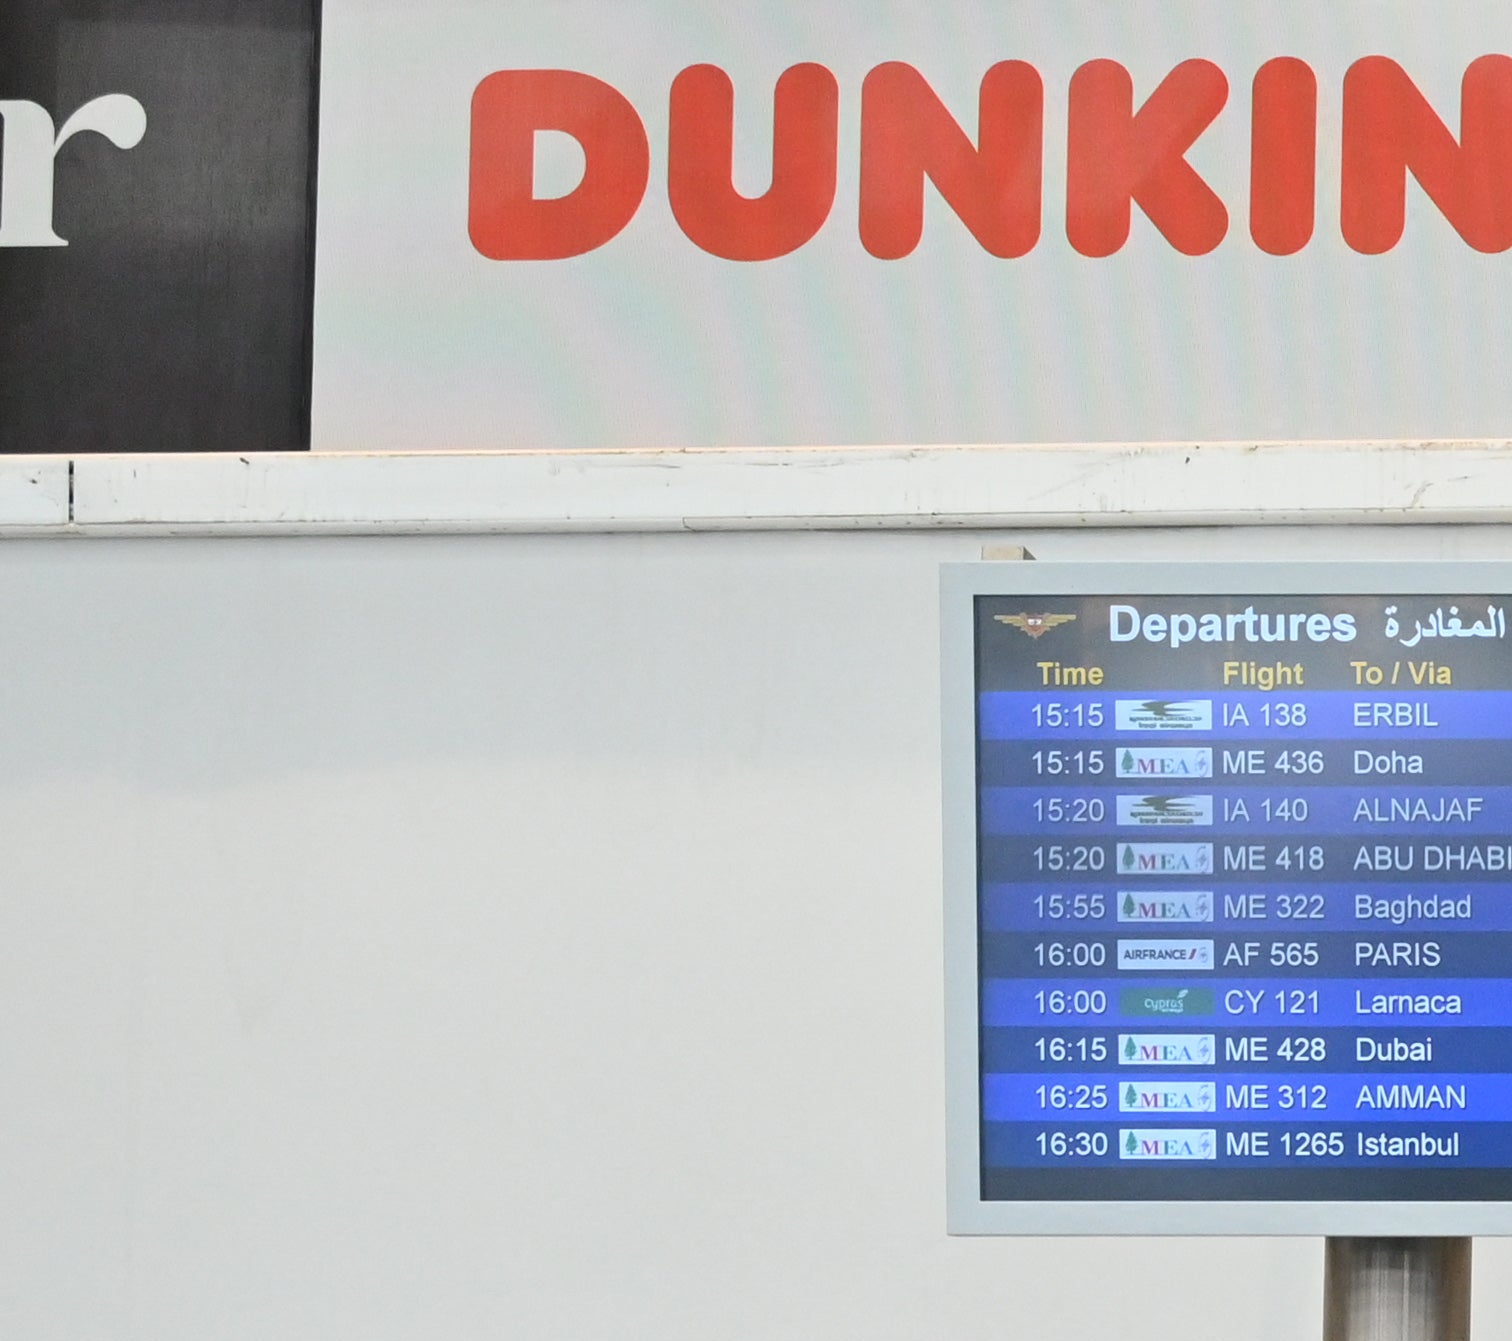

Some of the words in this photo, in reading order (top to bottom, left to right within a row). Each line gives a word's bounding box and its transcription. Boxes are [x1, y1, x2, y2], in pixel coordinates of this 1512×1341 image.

[1109, 604, 1358, 649] Departures
[1384, 604, 1506, 648] المغادرة
[1034, 942, 1106, 967] 16:00
[1222, 942, 1261, 966] AF
[1269, 942, 1319, 966] 565
[1355, 941, 1441, 967] PARIS
[1034, 990, 1107, 1014] 16:00
[1224, 989, 1265, 1014] CY
[1275, 989, 1318, 1014] 121
[1355, 989, 1462, 1014] Larnaca
[1036, 1131, 1108, 1156] 16:30
[1226, 1131, 1270, 1156] ME
[1280, 1131, 1345, 1156] 1265
[1357, 1131, 1459, 1156] Istanbul
